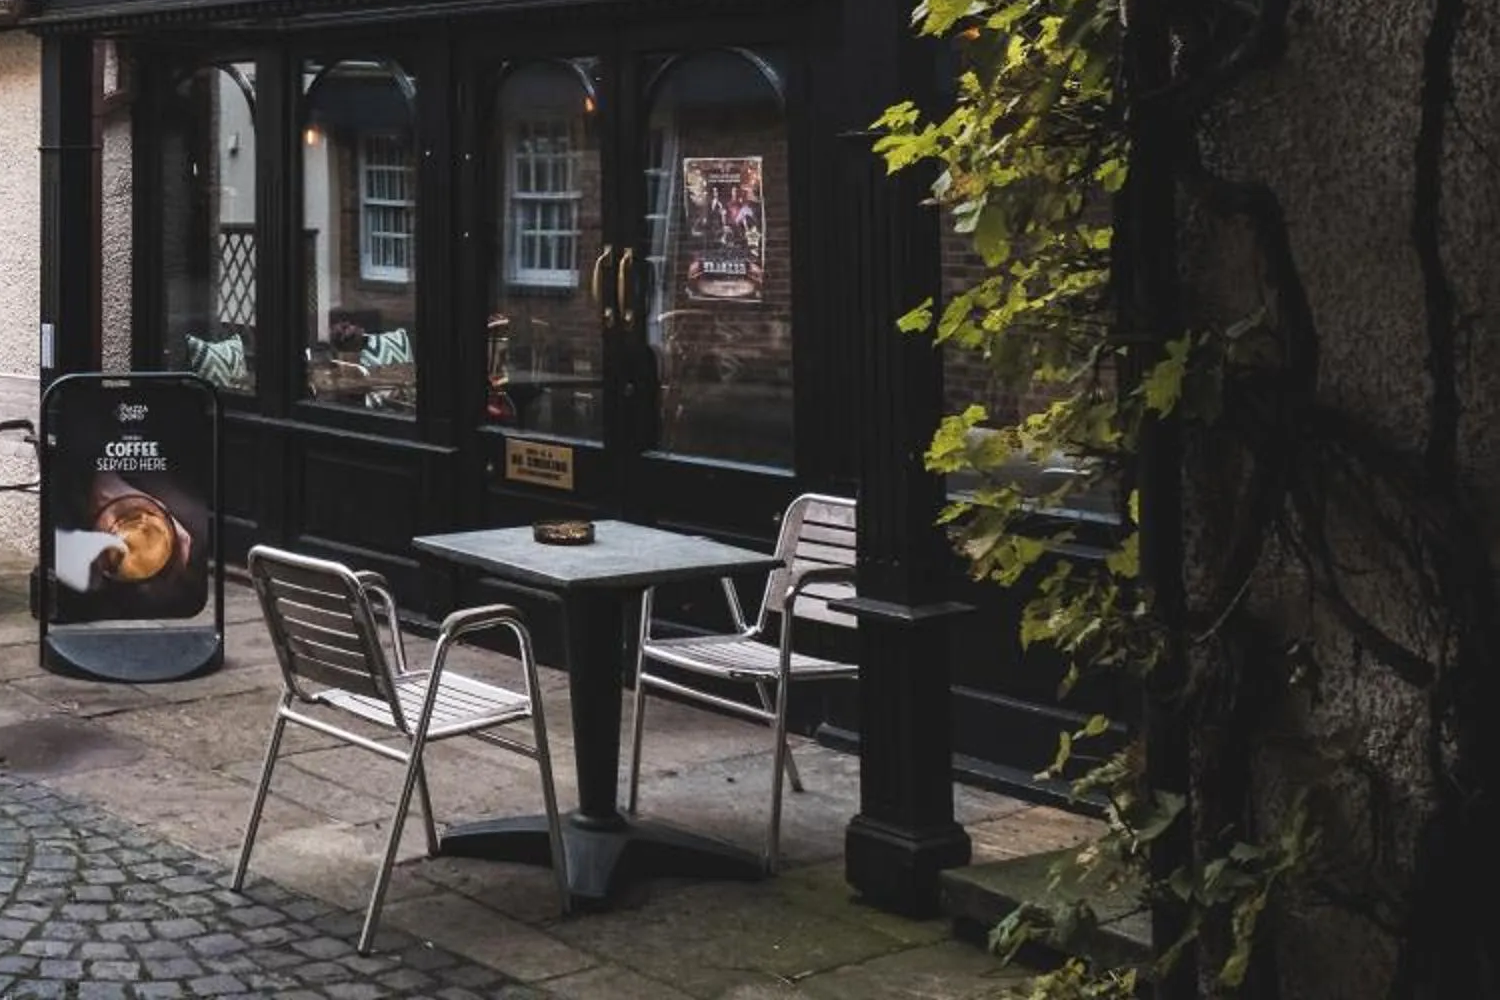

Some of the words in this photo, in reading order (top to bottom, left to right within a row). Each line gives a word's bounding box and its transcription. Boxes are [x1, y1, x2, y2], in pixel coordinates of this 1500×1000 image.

[105, 442, 159, 457] COFFEE
[96, 457, 138, 471] SERVED
[140, 457, 167, 471] HERE
